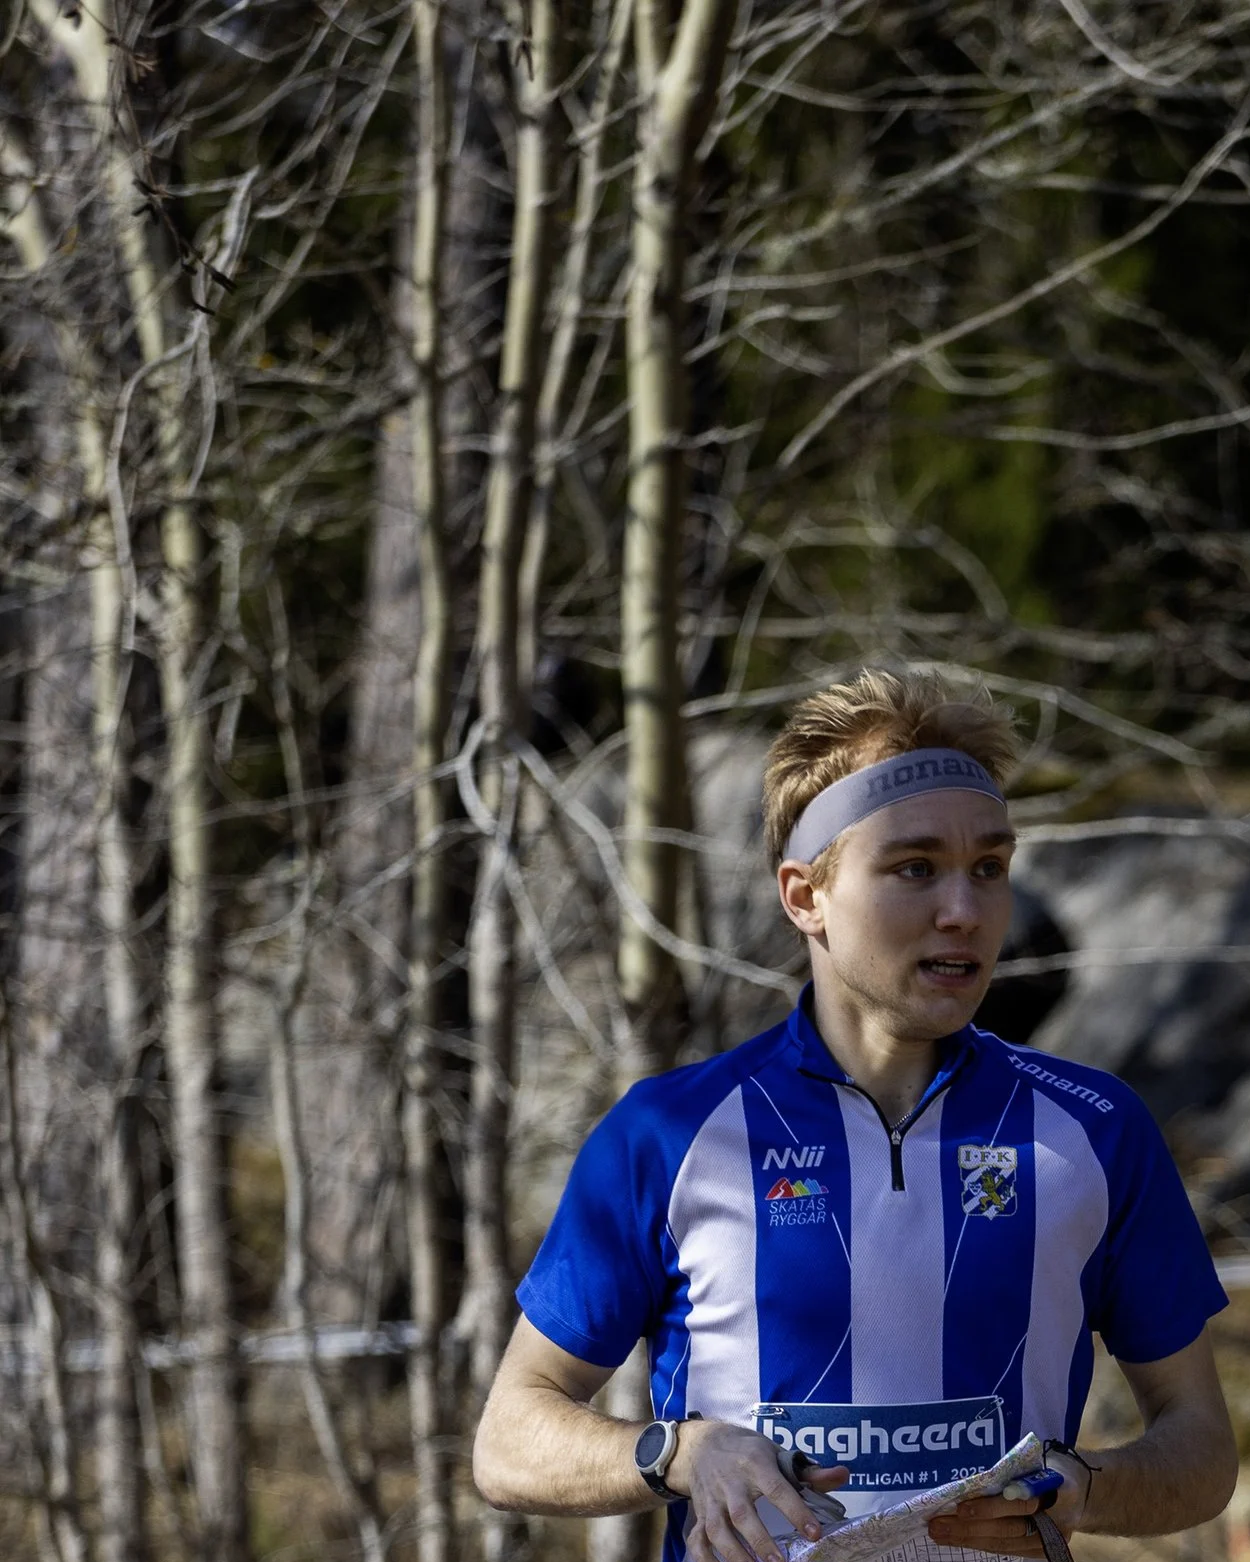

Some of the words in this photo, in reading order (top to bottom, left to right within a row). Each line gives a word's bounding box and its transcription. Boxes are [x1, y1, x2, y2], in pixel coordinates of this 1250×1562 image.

[1007, 1053, 1115, 1113] noname
[769, 1211, 827, 1226] RYGGAR
[763, 1418, 994, 1461] bagheera
